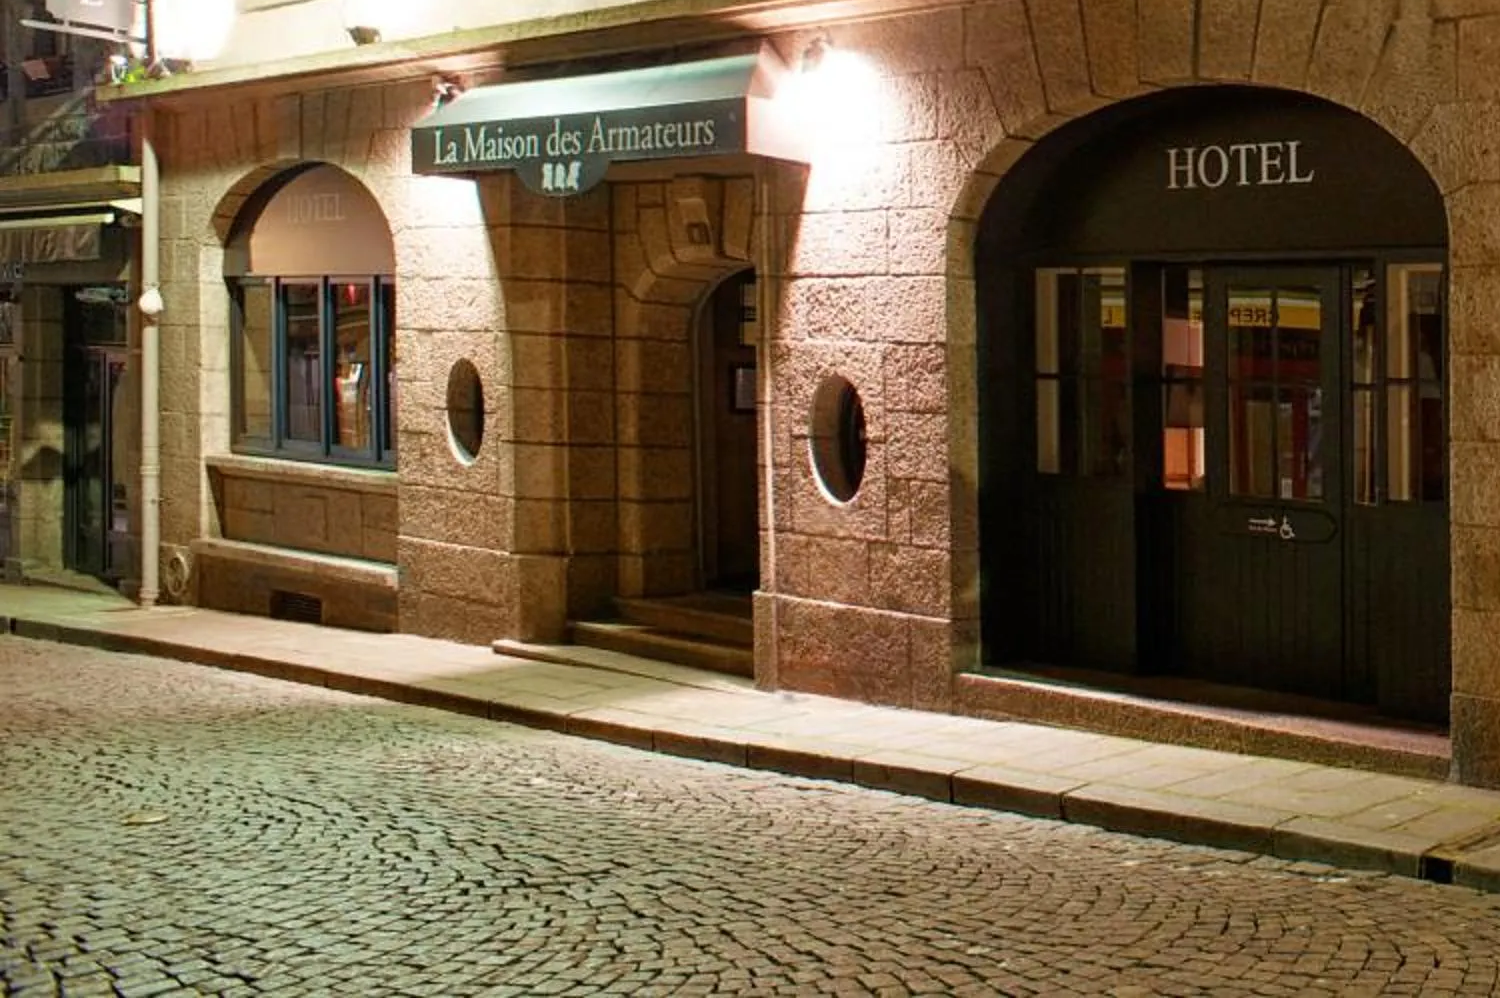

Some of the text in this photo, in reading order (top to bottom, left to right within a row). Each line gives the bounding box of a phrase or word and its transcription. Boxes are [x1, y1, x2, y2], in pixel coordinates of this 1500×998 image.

[434, 115, 715, 164] La Maison des Armateurs
[1167, 140, 1315, 189] HOTEL
